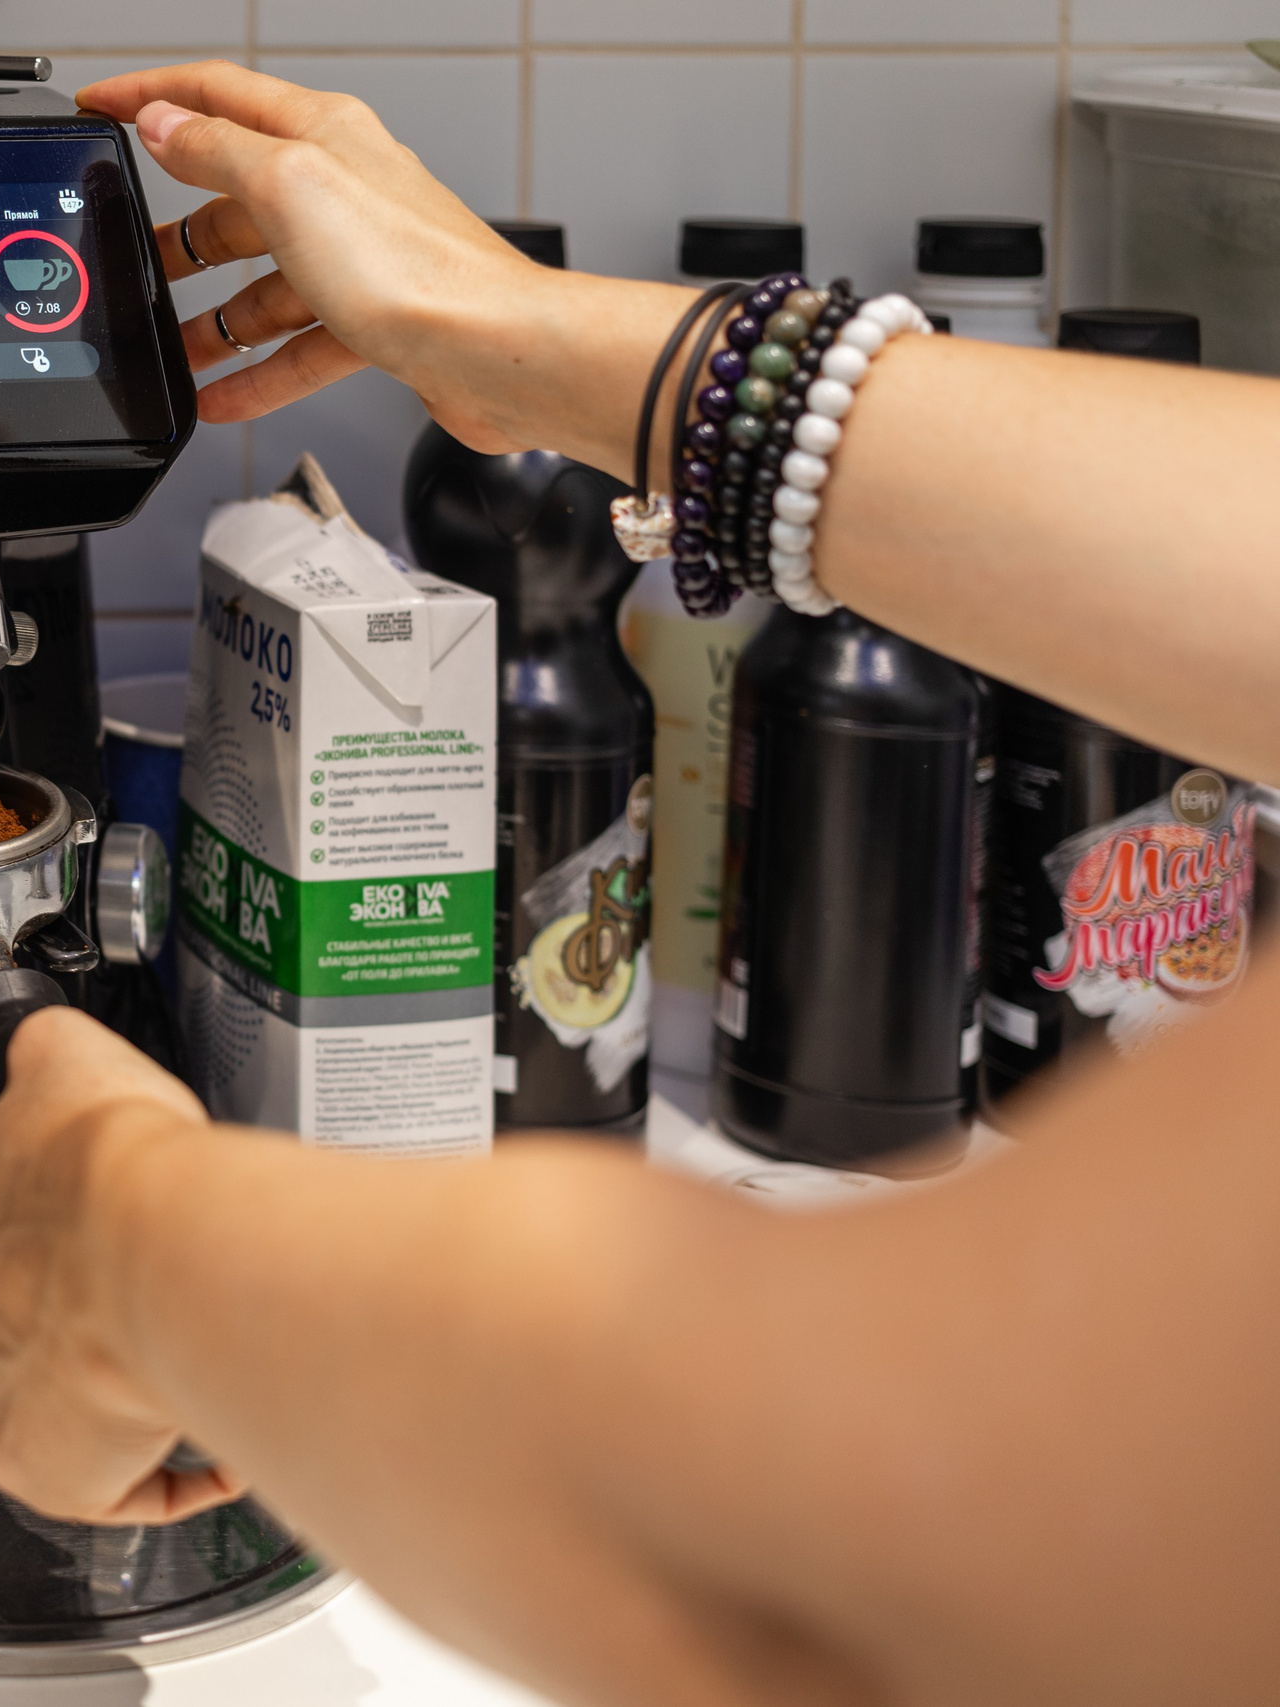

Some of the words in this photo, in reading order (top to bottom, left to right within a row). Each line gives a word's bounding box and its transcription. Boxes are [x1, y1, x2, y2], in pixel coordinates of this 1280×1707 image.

[62, 201, 77, 209] 147
[4, 210, 39, 221] Прямой
[37, 302, 61, 313] 7.08
[251, 682, 291, 732] 2,5%
[332, 732, 417, 747] ПРЕИМУЩЕСТВА
[420, 730, 465, 741] МОЛОКА
[371, 745, 447, 758] PROFESSIONAL
[329, 769, 373, 781] Прекрасно
[375, 767, 416, 778] подходит
[418, 765, 434, 775] для
[437, 764, 483, 774] латте-арта
[329, 786, 385, 798] Способствует
[329, 816, 370, 827] Подходит
[372, 814, 388, 824] для
